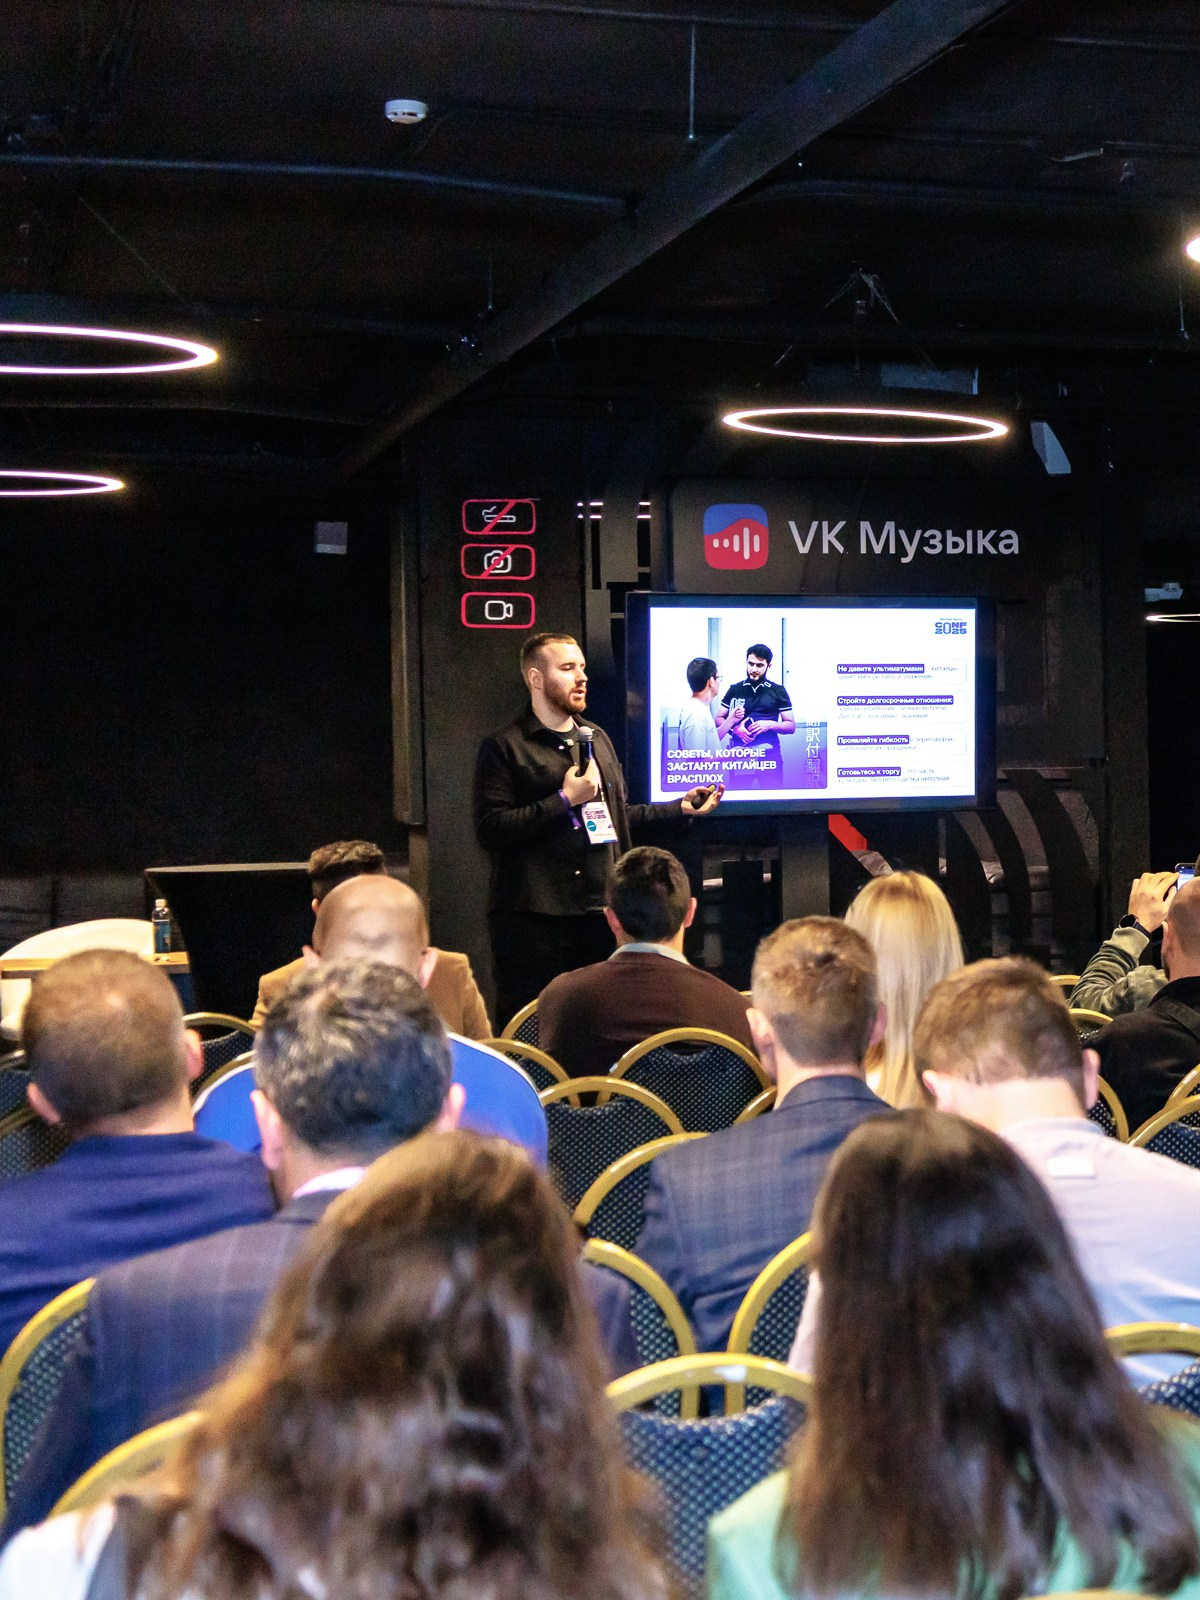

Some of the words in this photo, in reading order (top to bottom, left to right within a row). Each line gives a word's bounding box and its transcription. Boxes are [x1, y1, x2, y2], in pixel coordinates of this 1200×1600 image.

[788, 520, 847, 554] VK
[859, 520, 1019, 564] Музыка
[667, 749, 713, 759] СОВЕТЫ,
[715, 749, 766, 758] КОТОРЫЕ
[667, 761, 719, 771] ЗАСТАНУТ
[721, 759, 777, 771] КИТАЙЦЕВ
[667, 774, 724, 783] ВРАСПЛОХ
